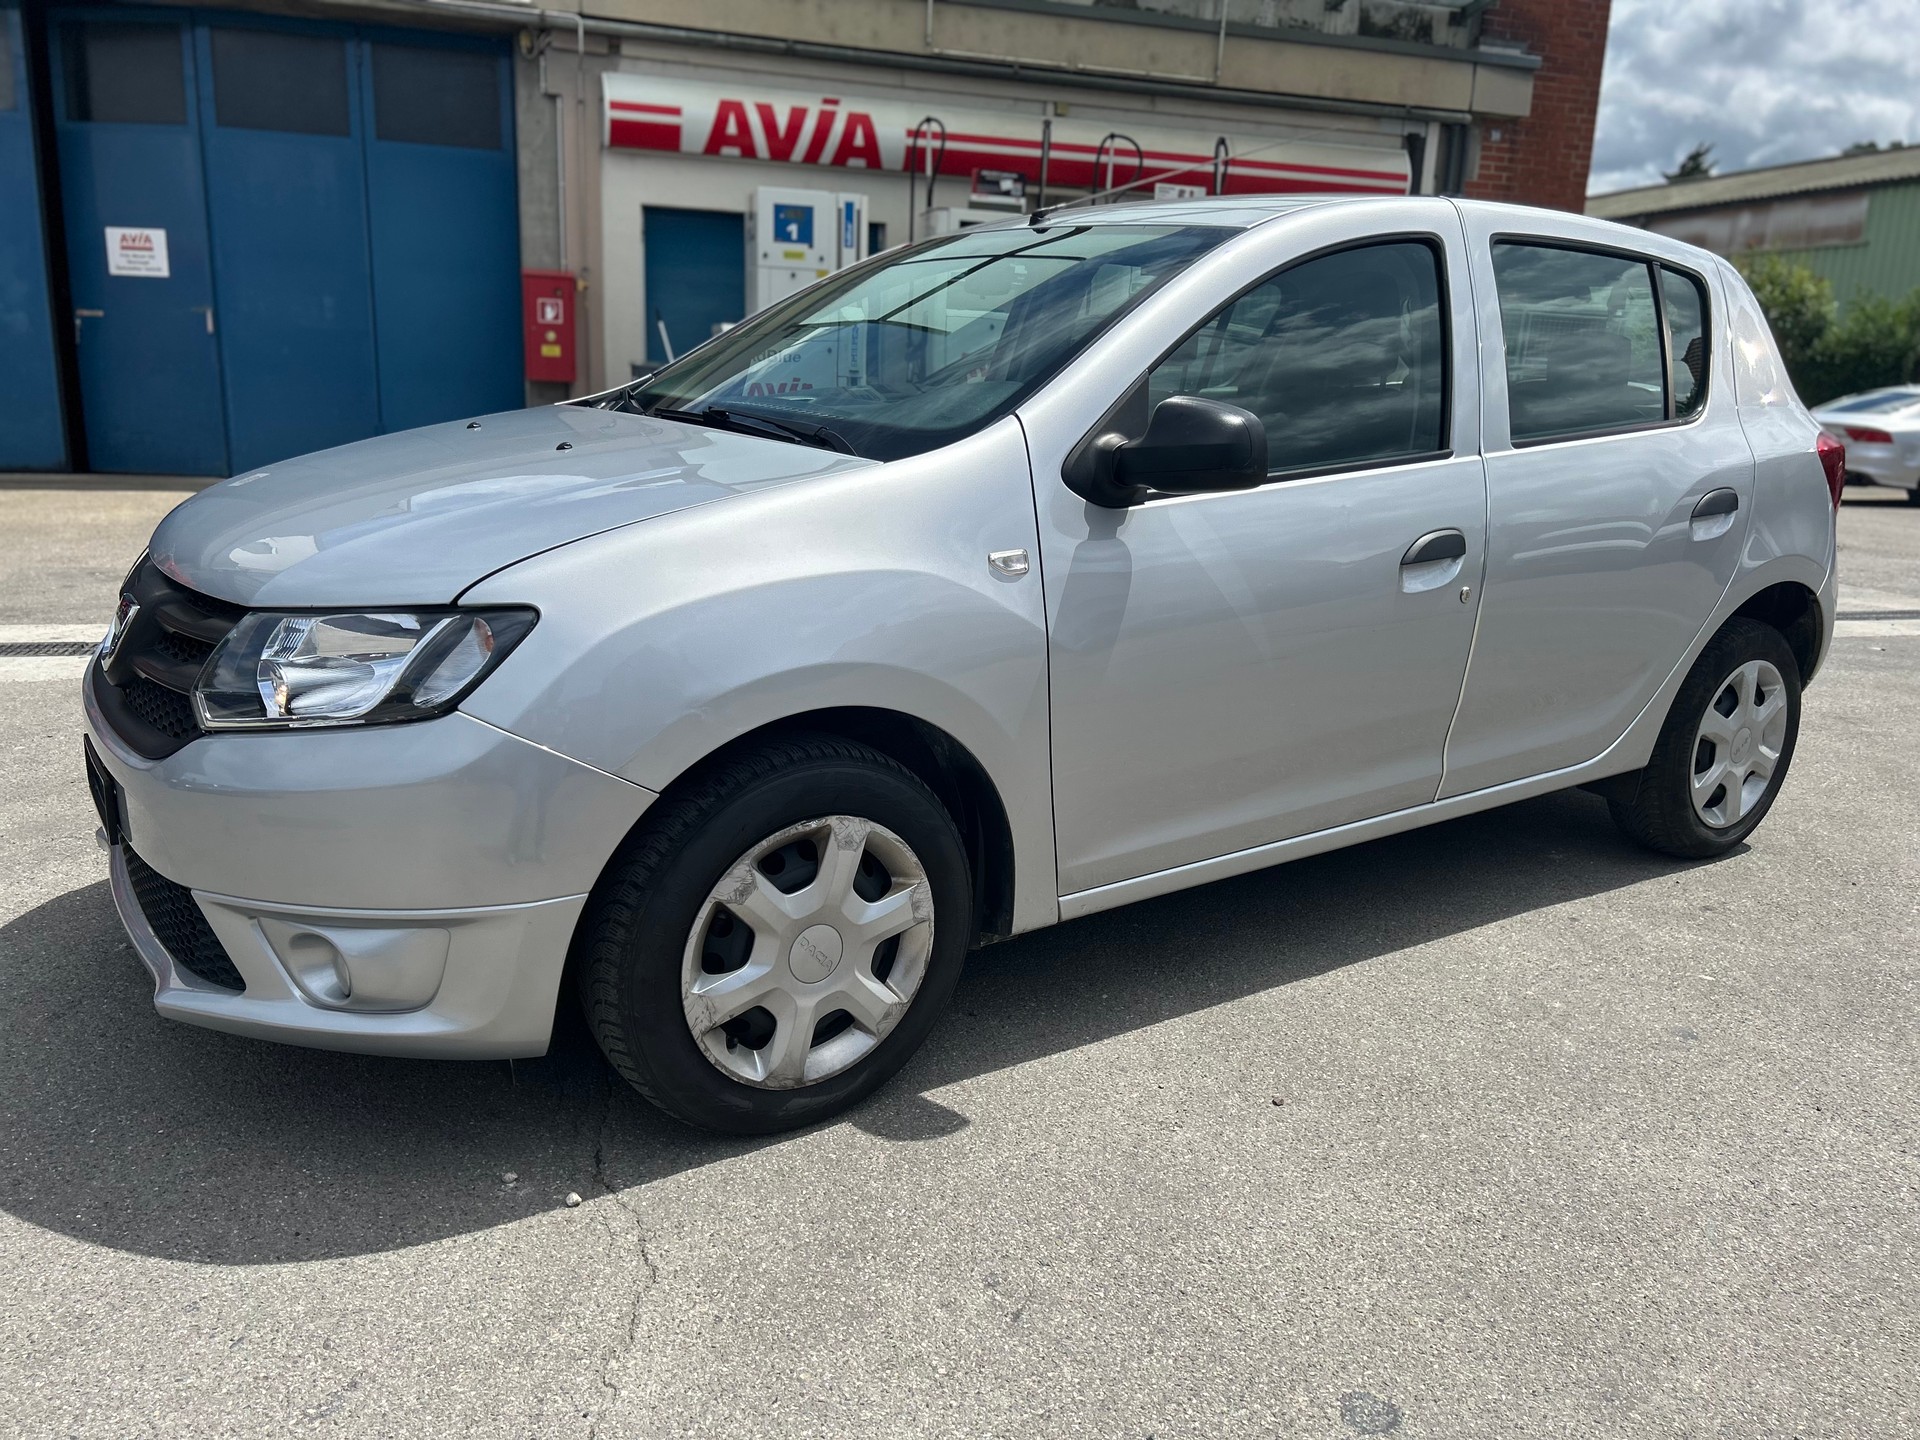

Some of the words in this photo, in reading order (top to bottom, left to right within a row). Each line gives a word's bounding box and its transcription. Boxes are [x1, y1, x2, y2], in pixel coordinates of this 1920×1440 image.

[703, 98, 883, 170] AVIA
[786, 222, 799, 241] 1
[798, 936, 833, 972] DACIA
